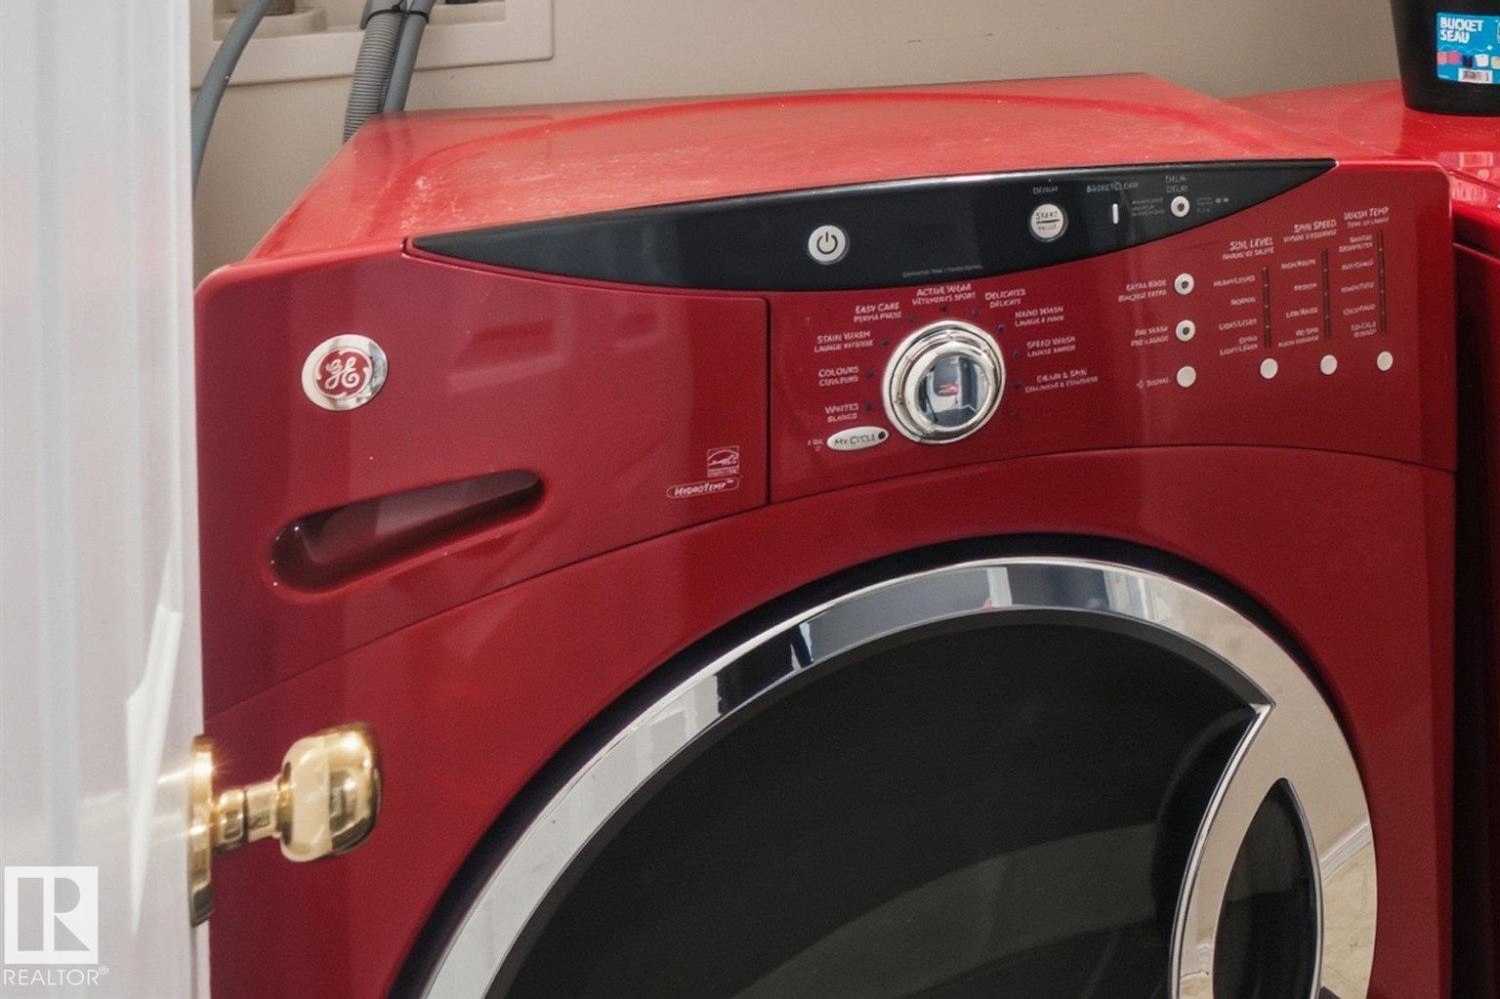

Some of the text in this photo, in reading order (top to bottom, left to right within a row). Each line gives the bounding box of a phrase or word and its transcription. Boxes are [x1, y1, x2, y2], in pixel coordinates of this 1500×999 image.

[1440, 16, 1484, 32] BUCKET
[1440, 29, 1470, 44] SEAU
[855, 302, 900, 314] EASY CARE
[818, 366, 859, 378] COLOURS
[824, 403, 859, 414] WHITES
